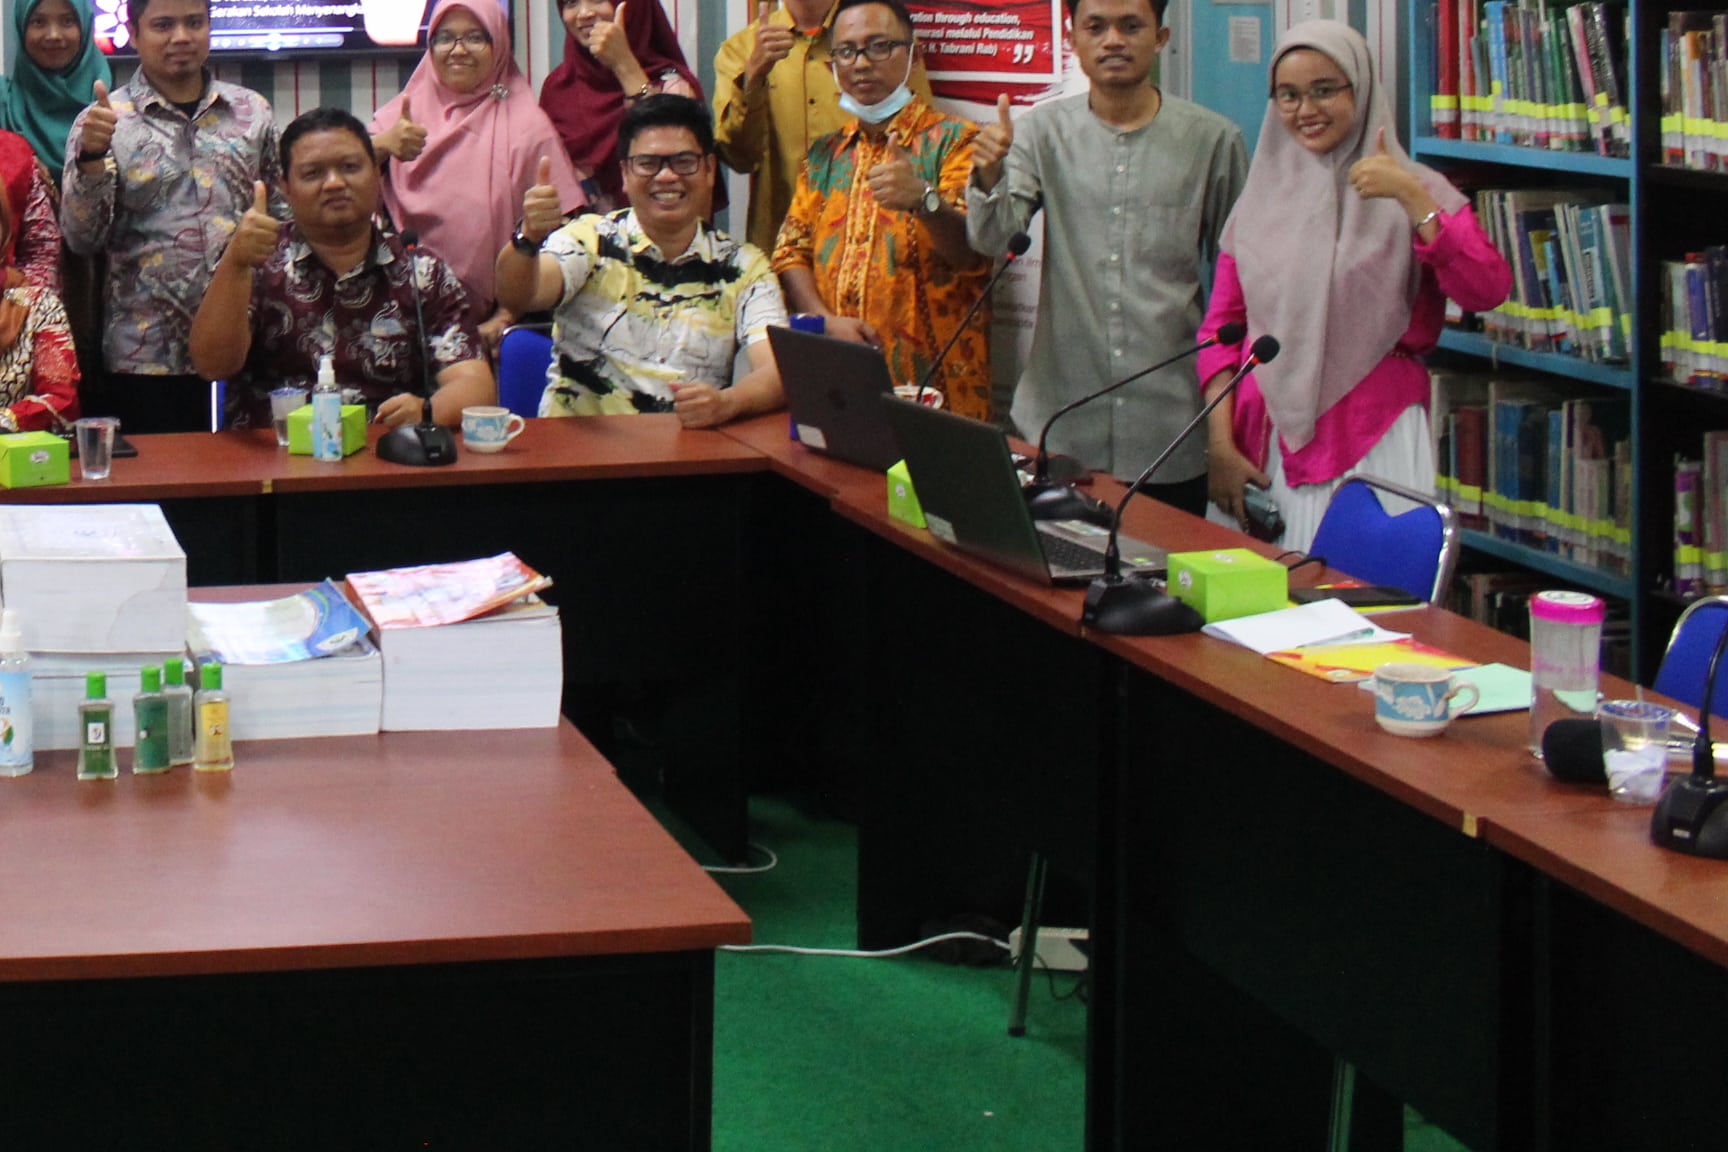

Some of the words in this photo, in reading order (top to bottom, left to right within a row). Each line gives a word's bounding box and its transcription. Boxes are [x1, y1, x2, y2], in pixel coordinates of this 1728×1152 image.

[934, 11, 972, 26] through
[973, 11, 1021, 26] education,
[982, 28, 1035, 40] Pendidikan
